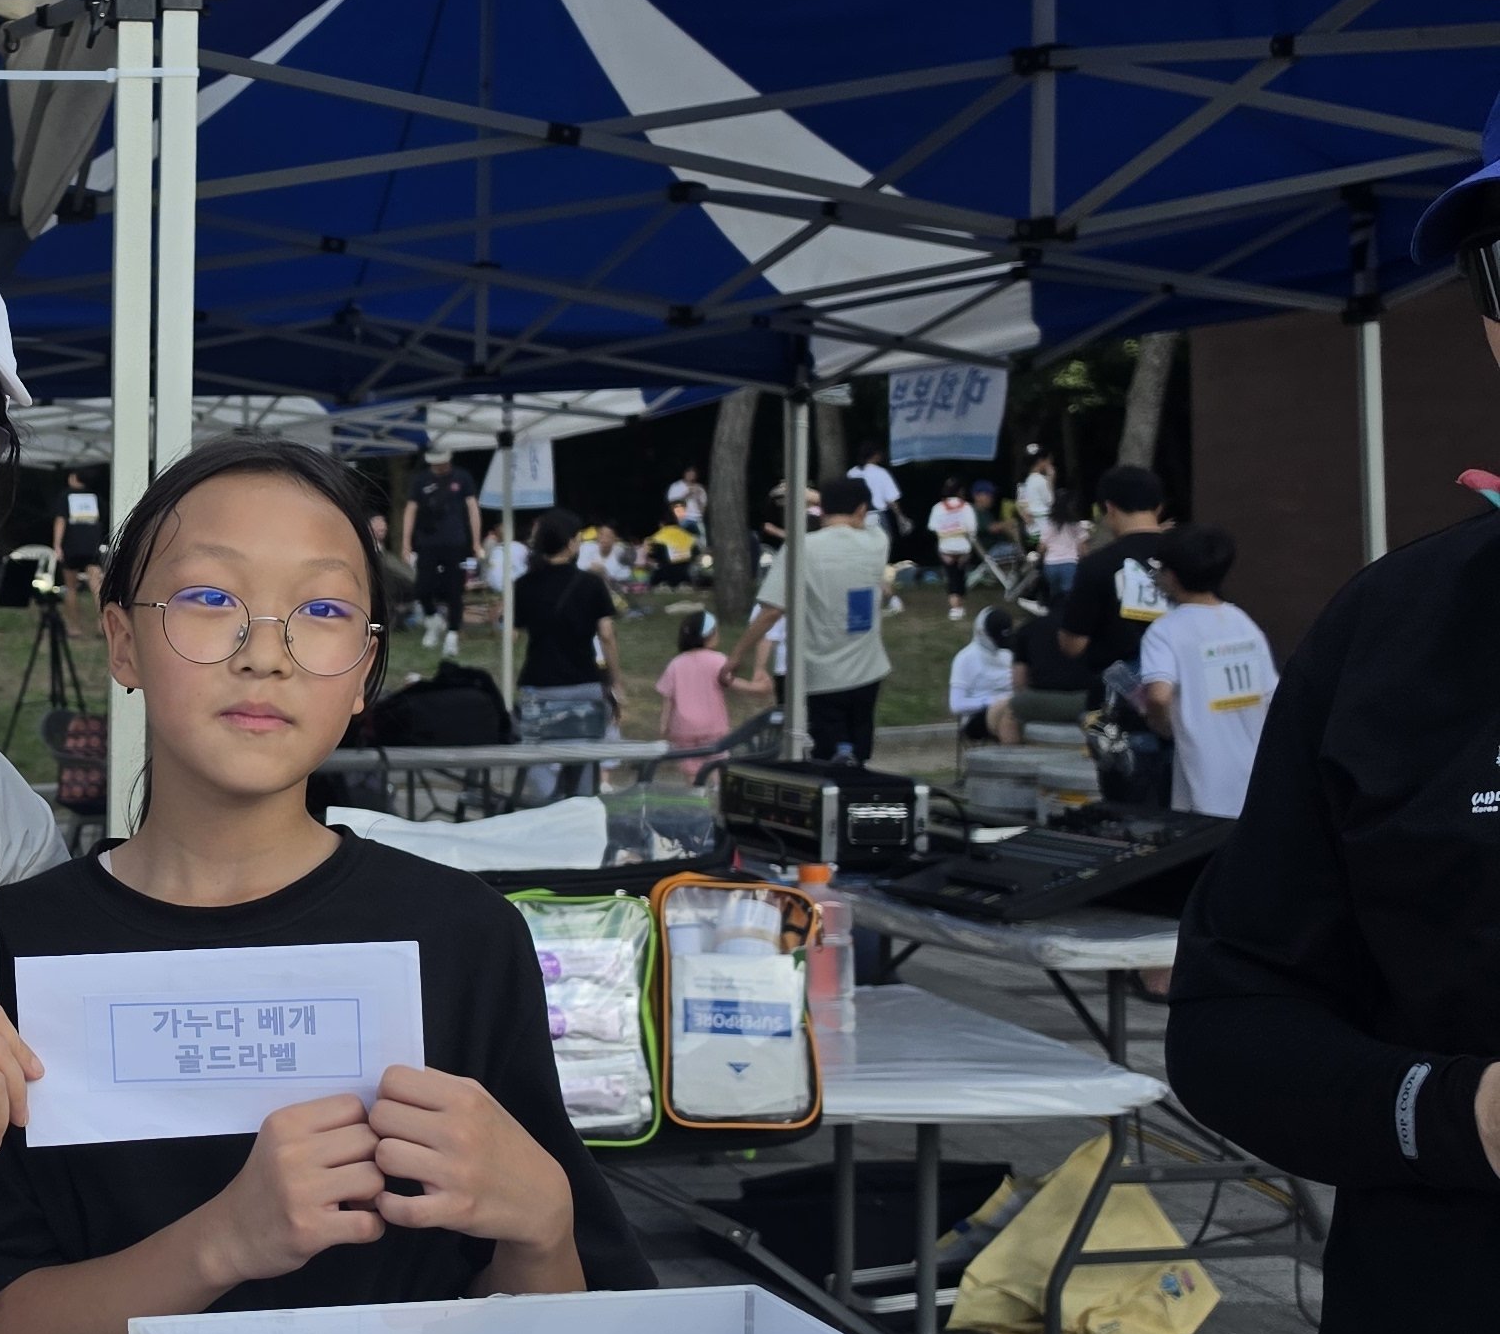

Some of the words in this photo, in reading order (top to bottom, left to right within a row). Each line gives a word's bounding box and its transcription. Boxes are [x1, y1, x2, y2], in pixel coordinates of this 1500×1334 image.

[1223, 662, 1252, 693] 111
[152, 1006, 245, 1038] 가누다
[257, 1004, 317, 1037] 베개
[693, 1012, 785, 1033] SUPERPORE
[174, 1041, 298, 1074] 골드라벨
